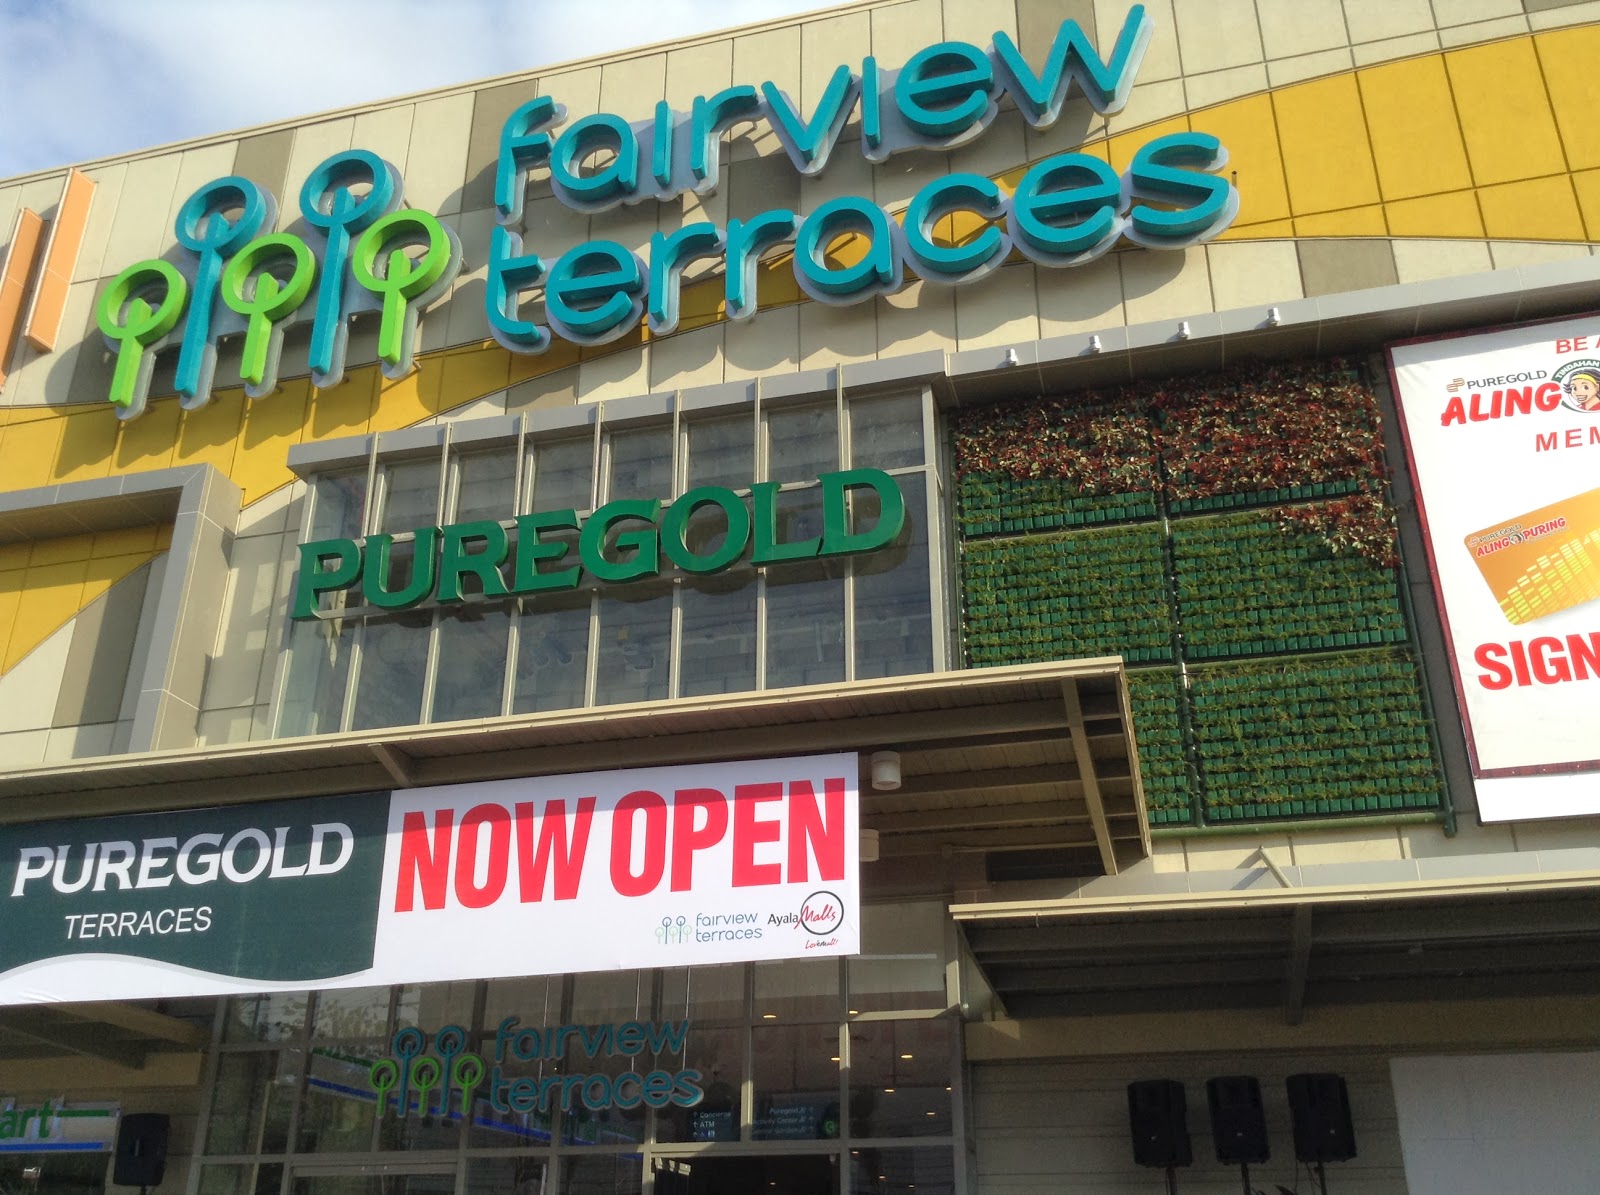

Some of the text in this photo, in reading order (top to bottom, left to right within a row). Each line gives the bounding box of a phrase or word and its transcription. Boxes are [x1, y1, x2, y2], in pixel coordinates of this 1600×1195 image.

[494, 3, 1148, 218] fairview
[486, 131, 1234, 348] terraces
[1556, 336, 1588, 354] BE
[1467, 370, 1548, 389] PUREGOLD
[1554, 360, 1600, 378] TINDAHAN
[1441, 381, 1562, 427] ALING
[291, 466, 906, 621] PUREGOLD
[1476, 537, 1510, 557] ALING
[1523, 517, 1567, 540] PURING
[1479, 523, 1522, 543] PUREGOLD
[1474, 631, 1600, 691] SIGN
[11, 822, 354, 897] PUREGOLD
[394, 777, 846, 912] NOW OPEN
[65, 906, 212, 939] TERRACES
[696, 912, 759, 927] fairview
[696, 926, 762, 943] terraces
[767, 904, 836, 929] Ayala Malls
[495, 1017, 689, 1061] fairview
[491, 1067, 704, 1112] terraces
